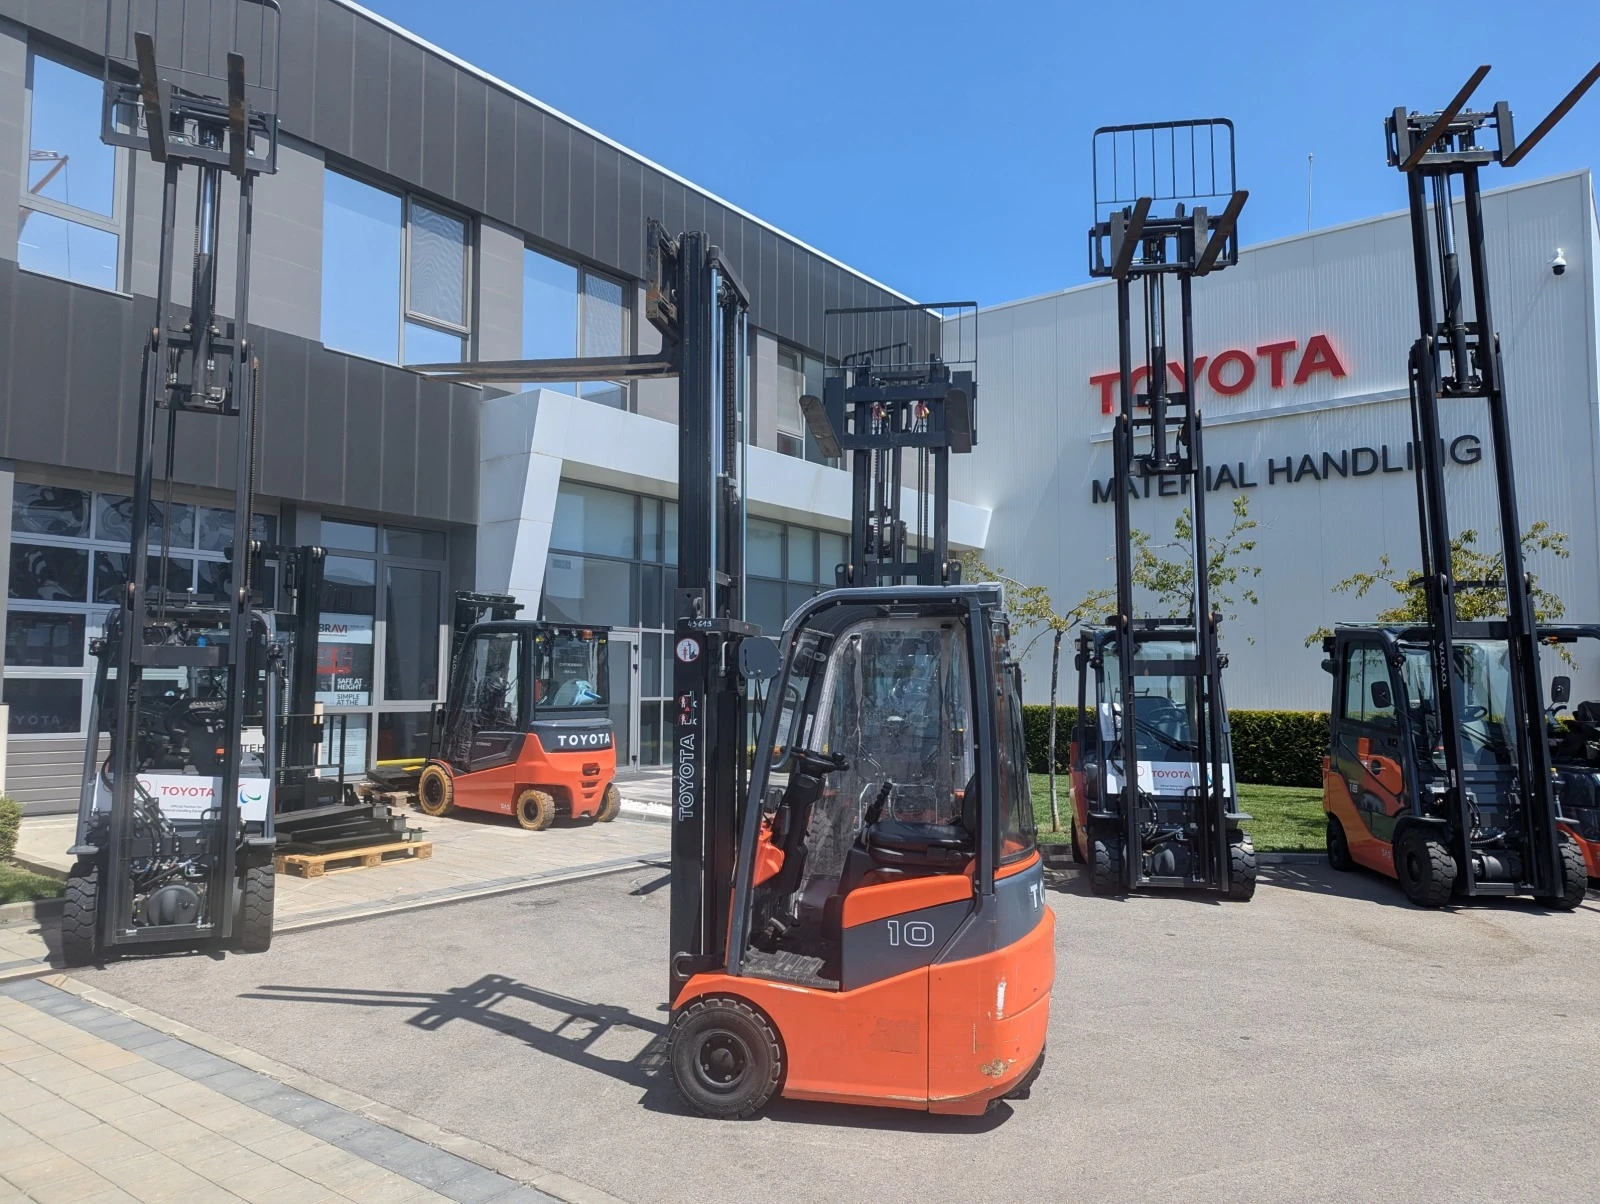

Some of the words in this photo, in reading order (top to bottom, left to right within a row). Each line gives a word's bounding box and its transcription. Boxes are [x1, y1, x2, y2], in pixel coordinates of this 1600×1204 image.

[1438, 641, 1447, 690] TOYOTA
[8, 715, 60, 725] YOTA
[558, 733, 611, 746] TOYOTA
[679, 733, 695, 822] TOYOTA
[1151, 770, 1191, 779] TOYOTA
[161, 786, 216, 797] TOYOTA
[887, 920, 935, 947] 10
